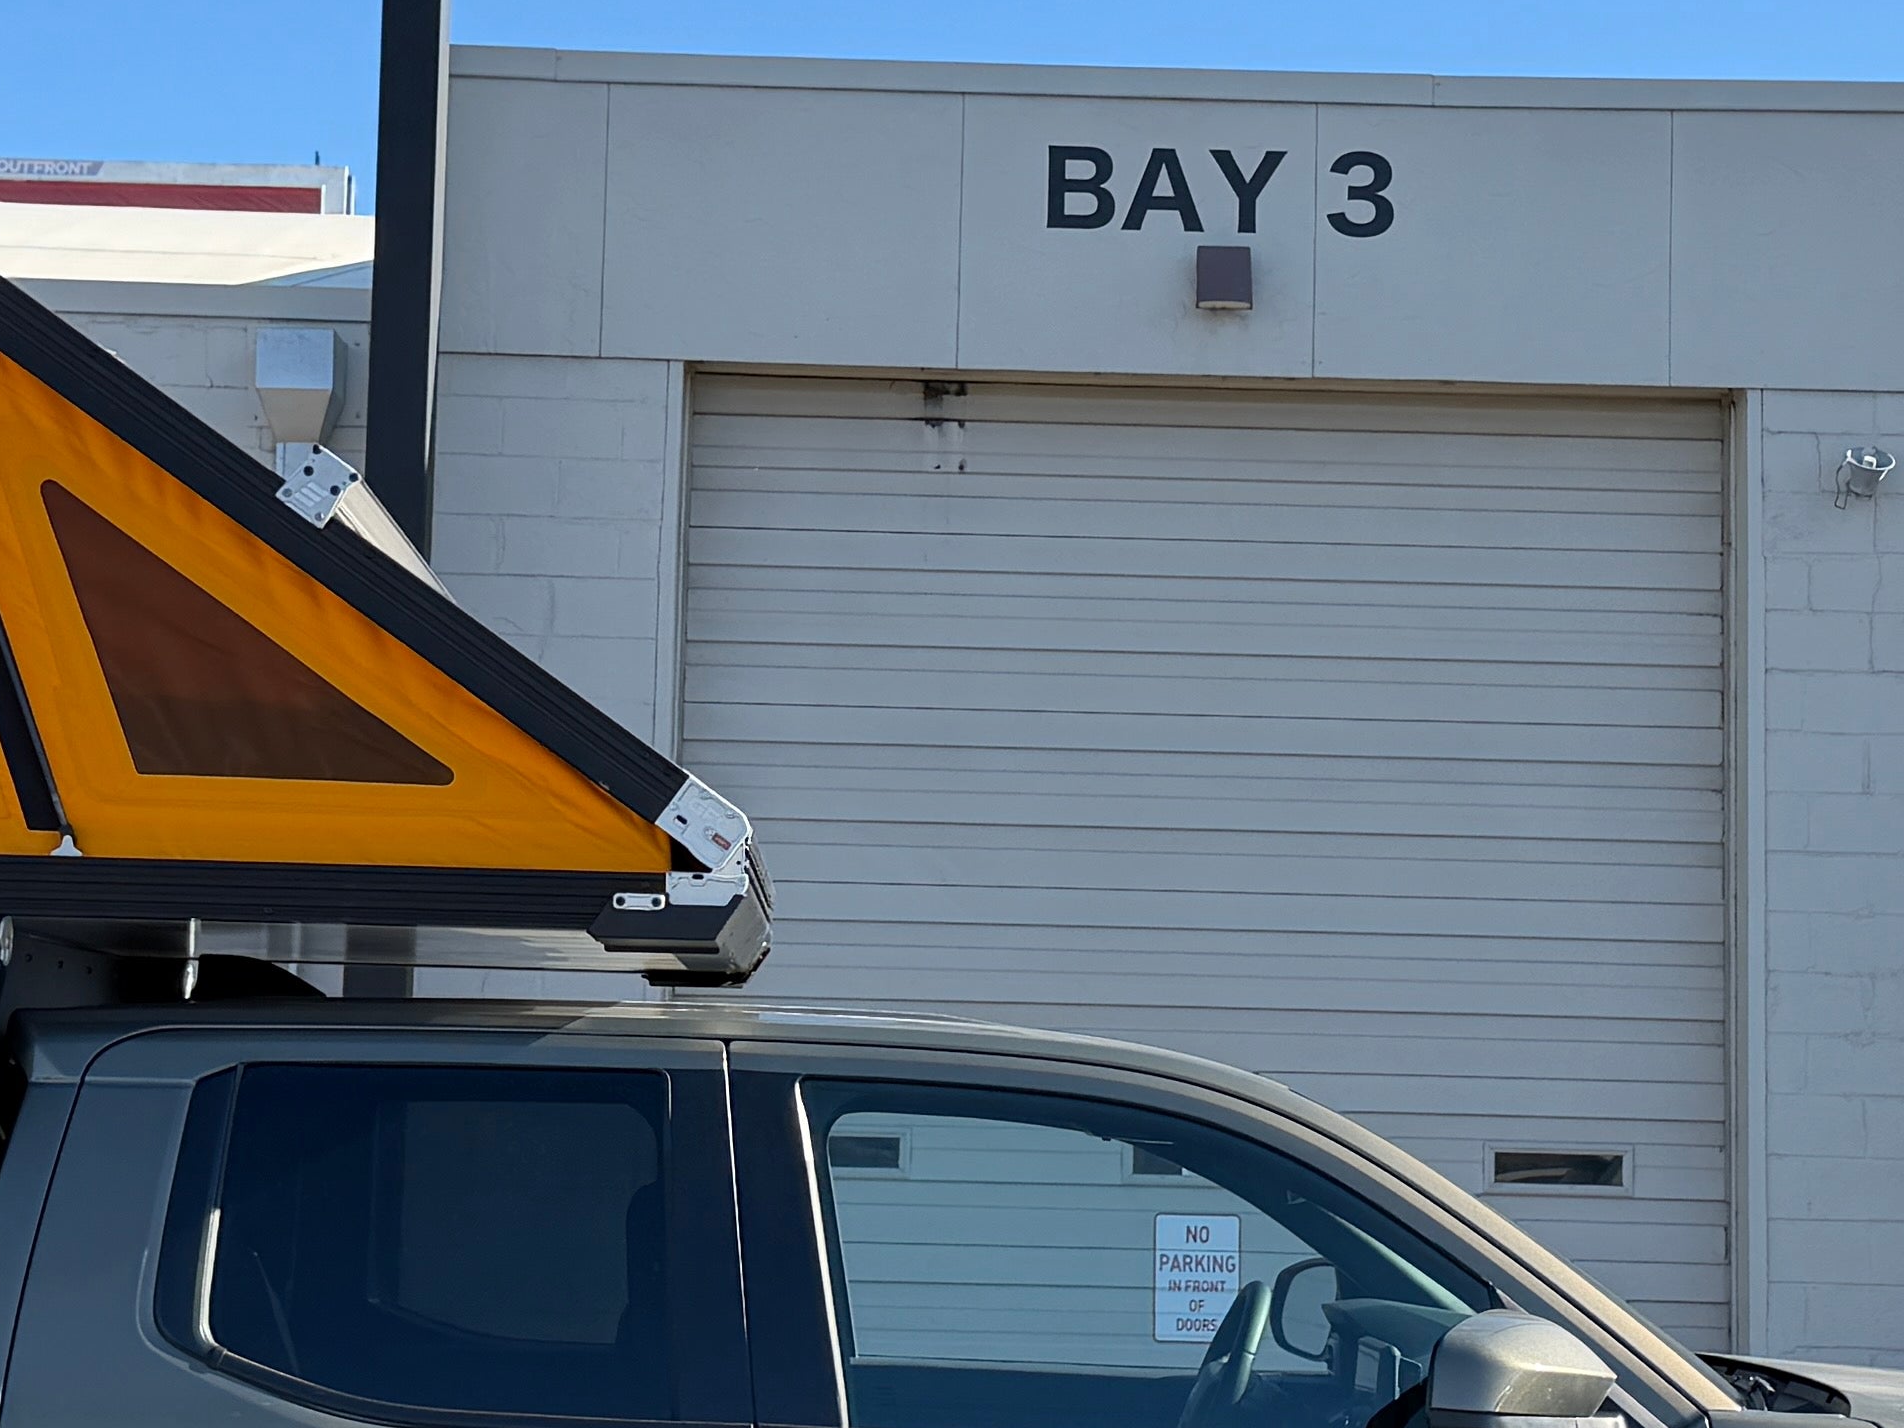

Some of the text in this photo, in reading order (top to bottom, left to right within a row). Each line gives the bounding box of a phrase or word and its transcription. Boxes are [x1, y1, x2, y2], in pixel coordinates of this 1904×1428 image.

[1046, 145, 1395, 238] BAY 3
[1185, 1225, 1210, 1244] NO
[1159, 1253, 1236, 1273] PARKING
[1168, 1280, 1226, 1292] IN FRONT
[1189, 1299, 1205, 1312] OF
[1176, 1318, 1217, 1332] DOORS
